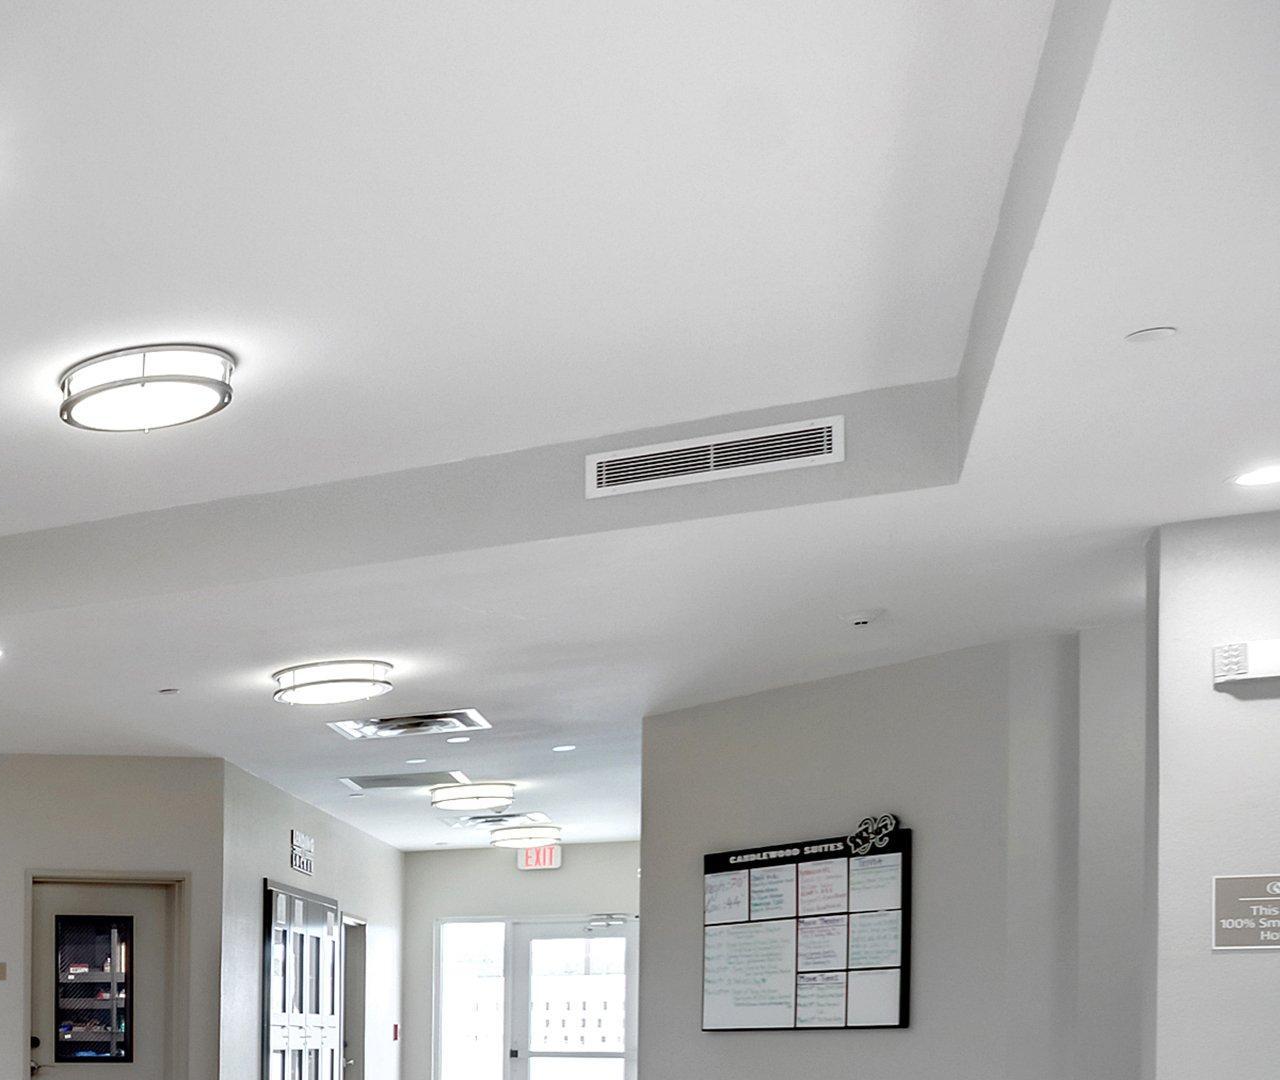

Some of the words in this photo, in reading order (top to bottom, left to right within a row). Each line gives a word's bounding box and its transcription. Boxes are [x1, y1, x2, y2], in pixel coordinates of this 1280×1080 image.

[525, 845, 555, 867] EXIT
[729, 847, 800, 864] CANDLEWOOD
[804, 842, 844, 855] SUITES
[1249, 905, 1280, 916] This
[1219, 918, 1256, 929] 100%
[1260, 930, 1280, 941] Ho
